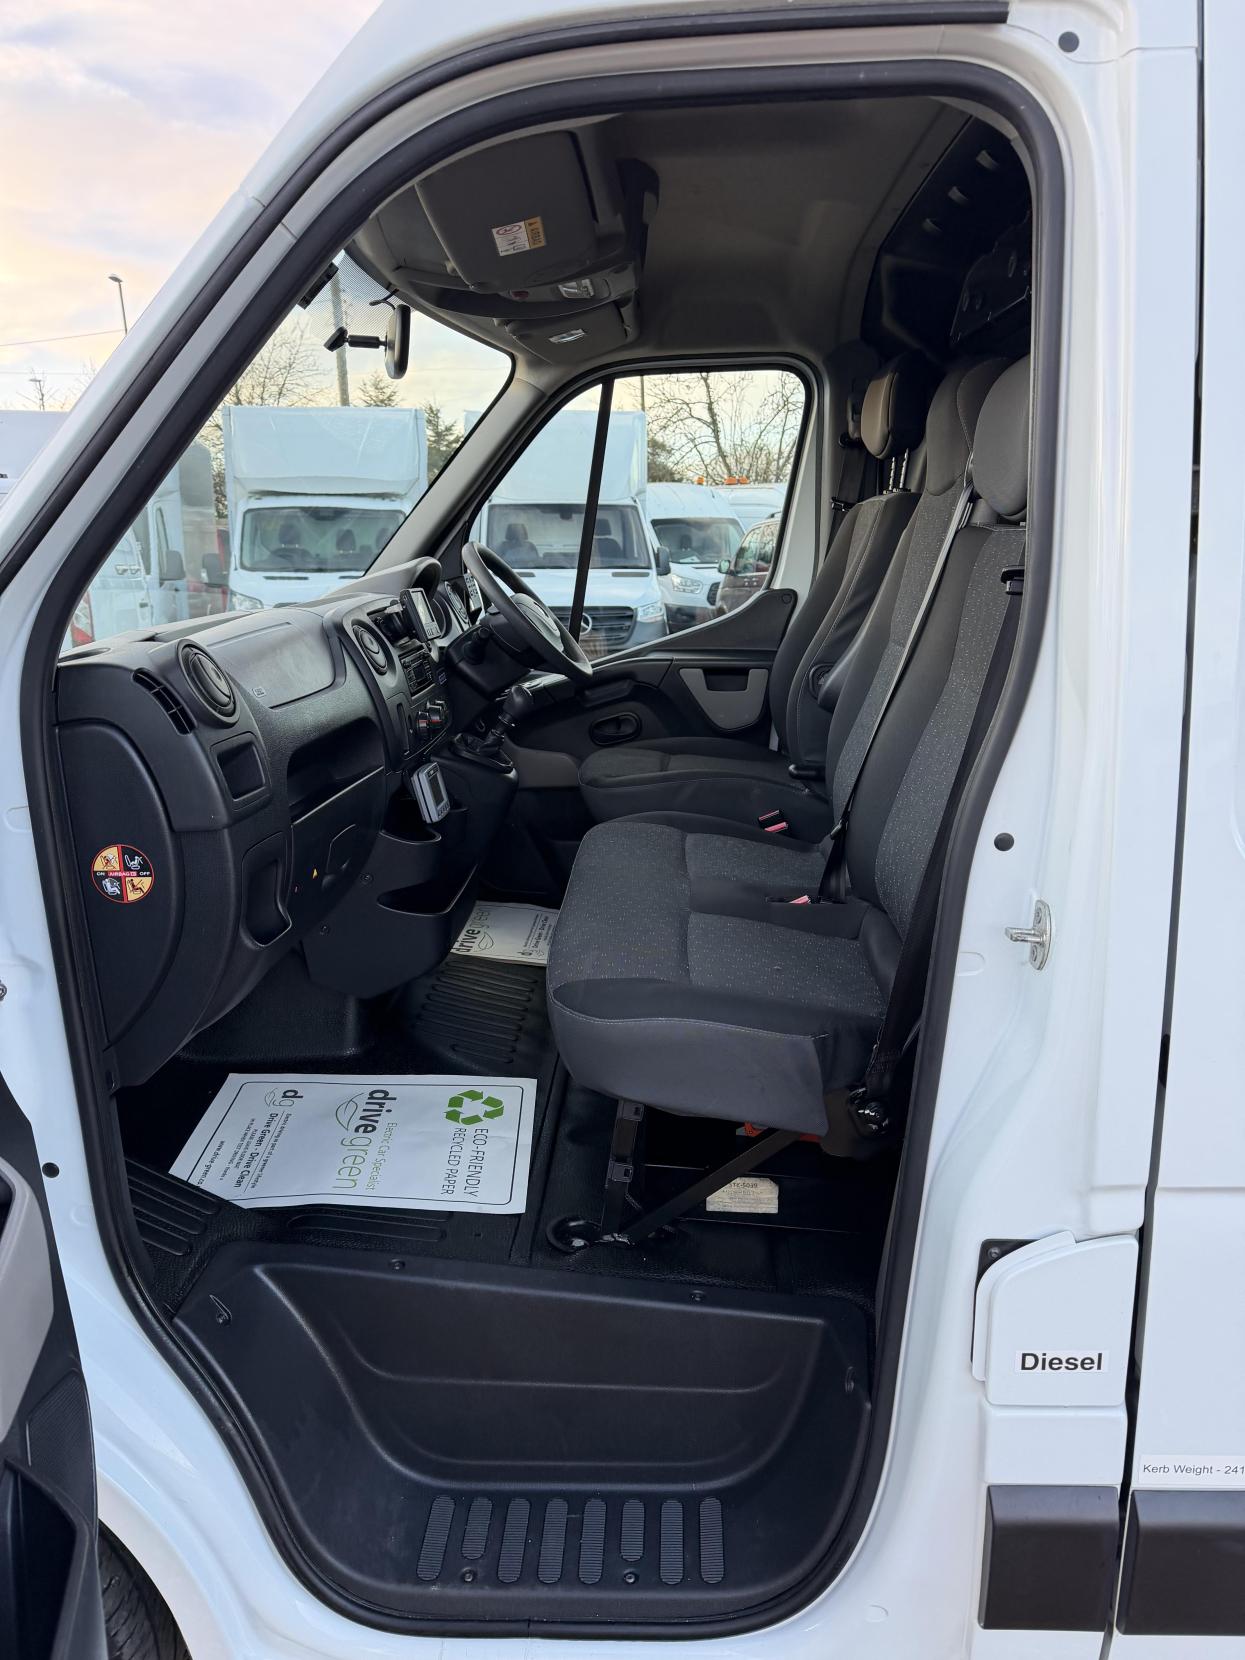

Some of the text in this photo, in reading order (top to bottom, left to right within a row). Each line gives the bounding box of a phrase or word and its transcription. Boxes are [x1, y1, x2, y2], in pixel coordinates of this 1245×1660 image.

[273, 1089, 303, 1107] dg
[265, 1112, 278, 1128] Drive
[256, 1129, 270, 1147] Green
[332, 1089, 397, 1190] drive green
[245, 1152, 259, 1169] Drive
[365, 1122, 398, 1191] Electric Car Specialist
[440, 1127, 467, 1196] RECYCLED PAPER
[463, 1128, 489, 1197] ECO-FRIENDLY
[235, 1169, 250, 1188] Clean
[1021, 1352, 1103, 1371] Diesel
[1143, 1464, 1170, 1474] Kerb
[1173, 1464, 1213, 1476] Weight
